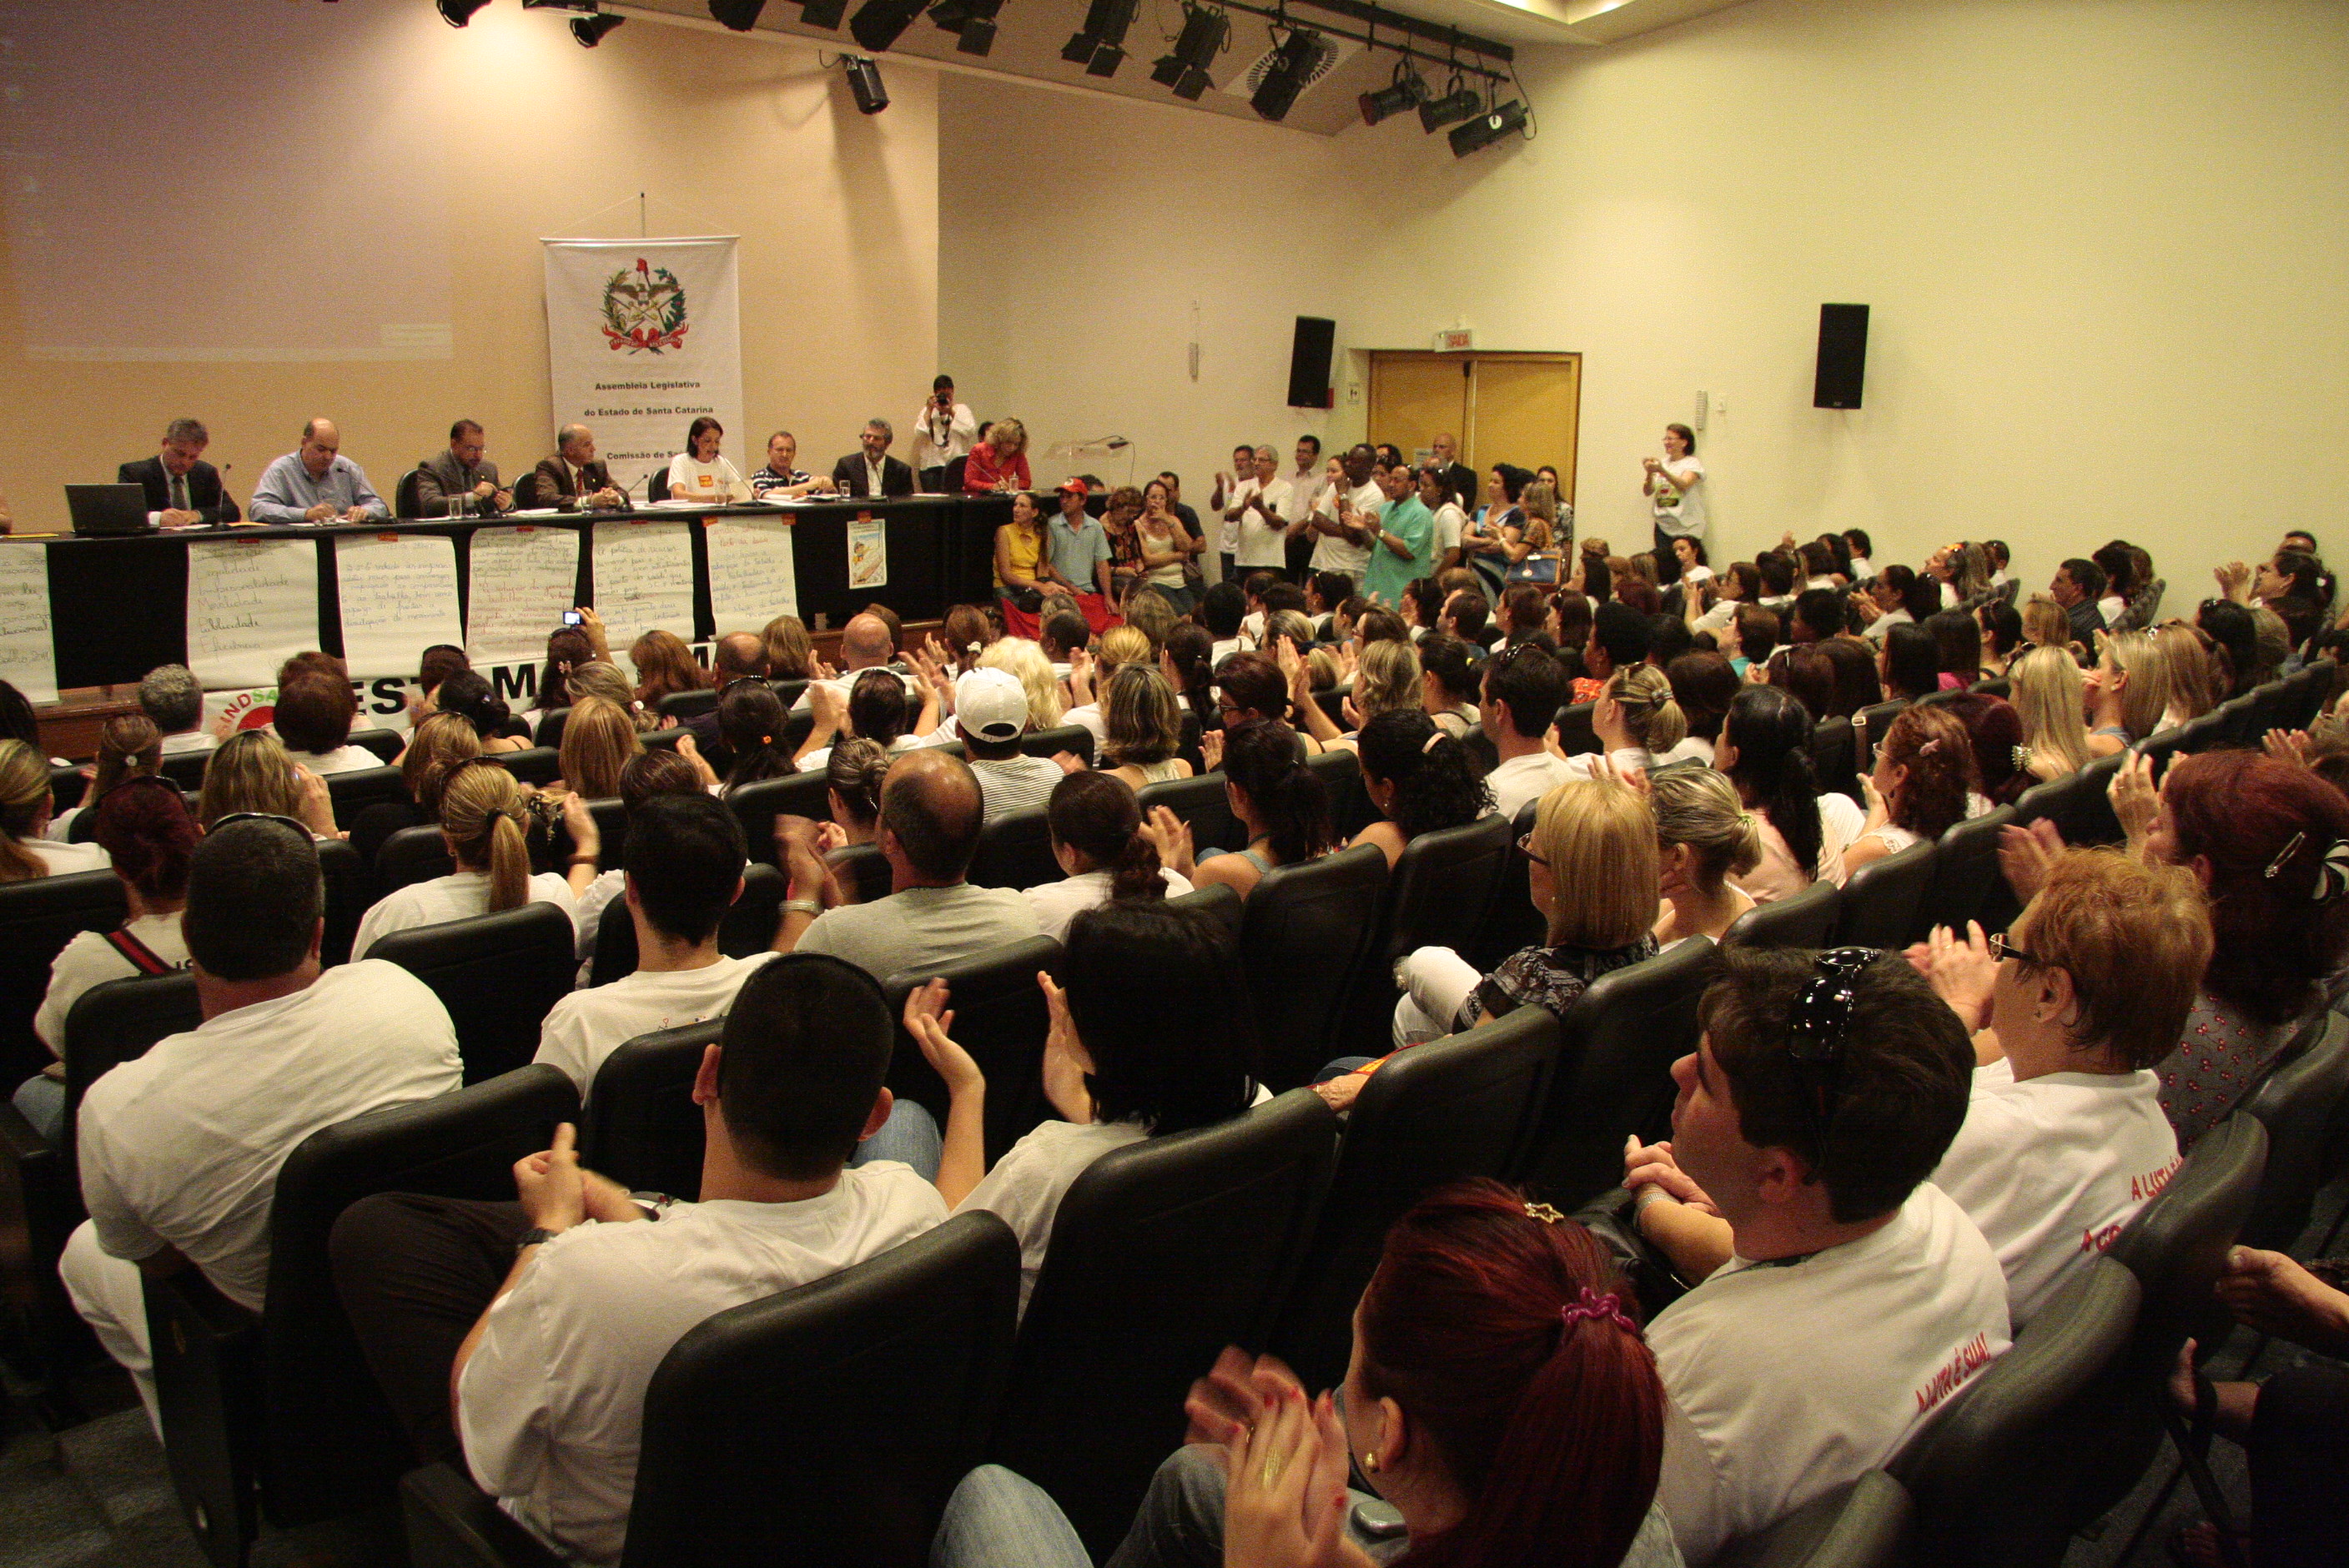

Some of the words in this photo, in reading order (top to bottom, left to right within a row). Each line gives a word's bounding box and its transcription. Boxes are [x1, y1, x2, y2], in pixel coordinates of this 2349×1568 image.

[595, 382, 648, 390] Assembleia
[651, 381, 701, 391] Legislativa
[584, 408, 596, 416] do
[598, 408, 630, 416] Estado
[646, 407, 672, 415] Santa
[675, 406, 713, 415] Catarina
[606, 450, 651, 460] Comissão
[2131, 1175, 2142, 1201] A
